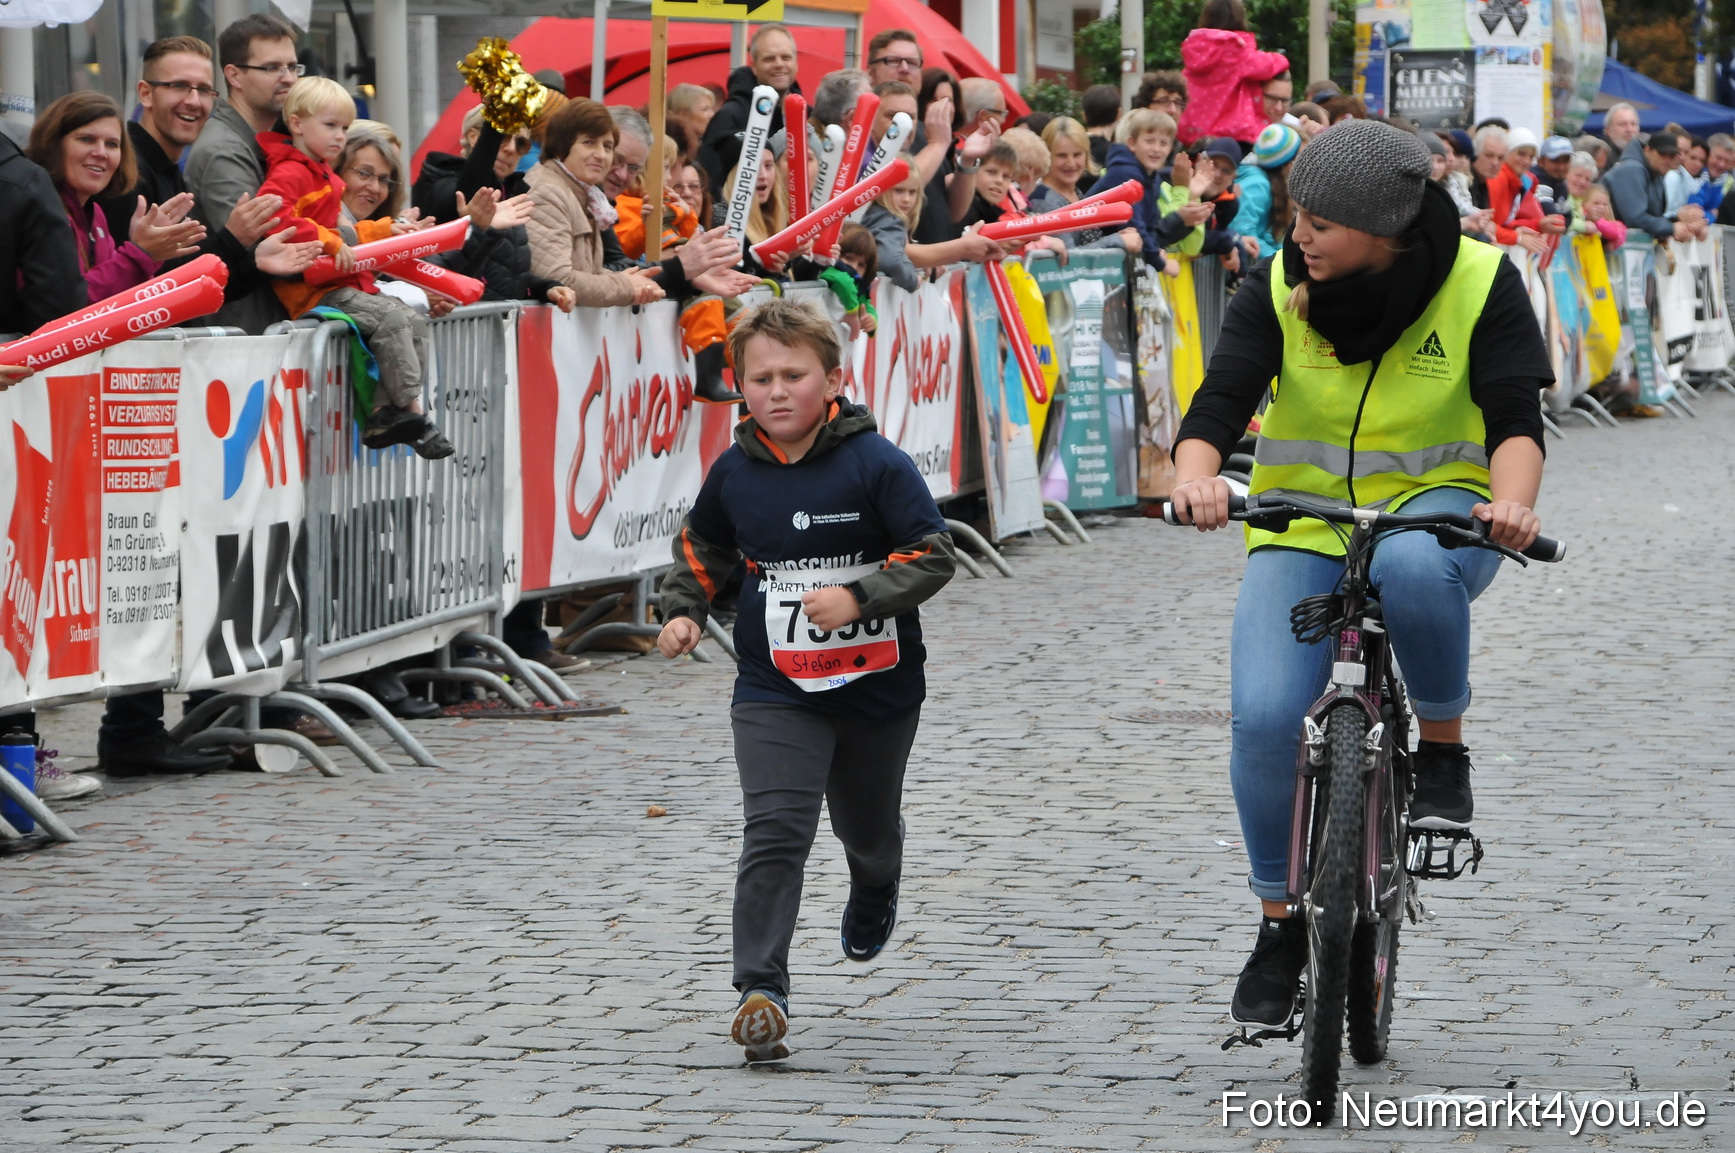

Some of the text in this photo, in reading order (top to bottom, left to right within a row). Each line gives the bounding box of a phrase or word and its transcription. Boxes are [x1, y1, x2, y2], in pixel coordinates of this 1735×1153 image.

[836, 163, 851, 188] BKK
[788, 169, 797, 220] Audi BKK
[796, 206, 847, 245] Audi BKK
[1006, 212, 1061, 229] Audi BKK
[411, 243, 440, 258] Audi
[26, 327, 113, 367] Audi BKK
[1408, 364, 1451, 375] einfach besser.
[88, 395, 97, 428] 1929
[107, 513, 138, 529] Braun
[107, 534, 122, 550] Am
[107, 555, 147, 572] D-92318
[107, 586, 124, 603] Tel.
[770, 582, 809, 593] PARTL
[107, 608, 123, 624] Fax
[1341, 631, 1359, 643] STS
[791, 653, 841, 673] Stefan
